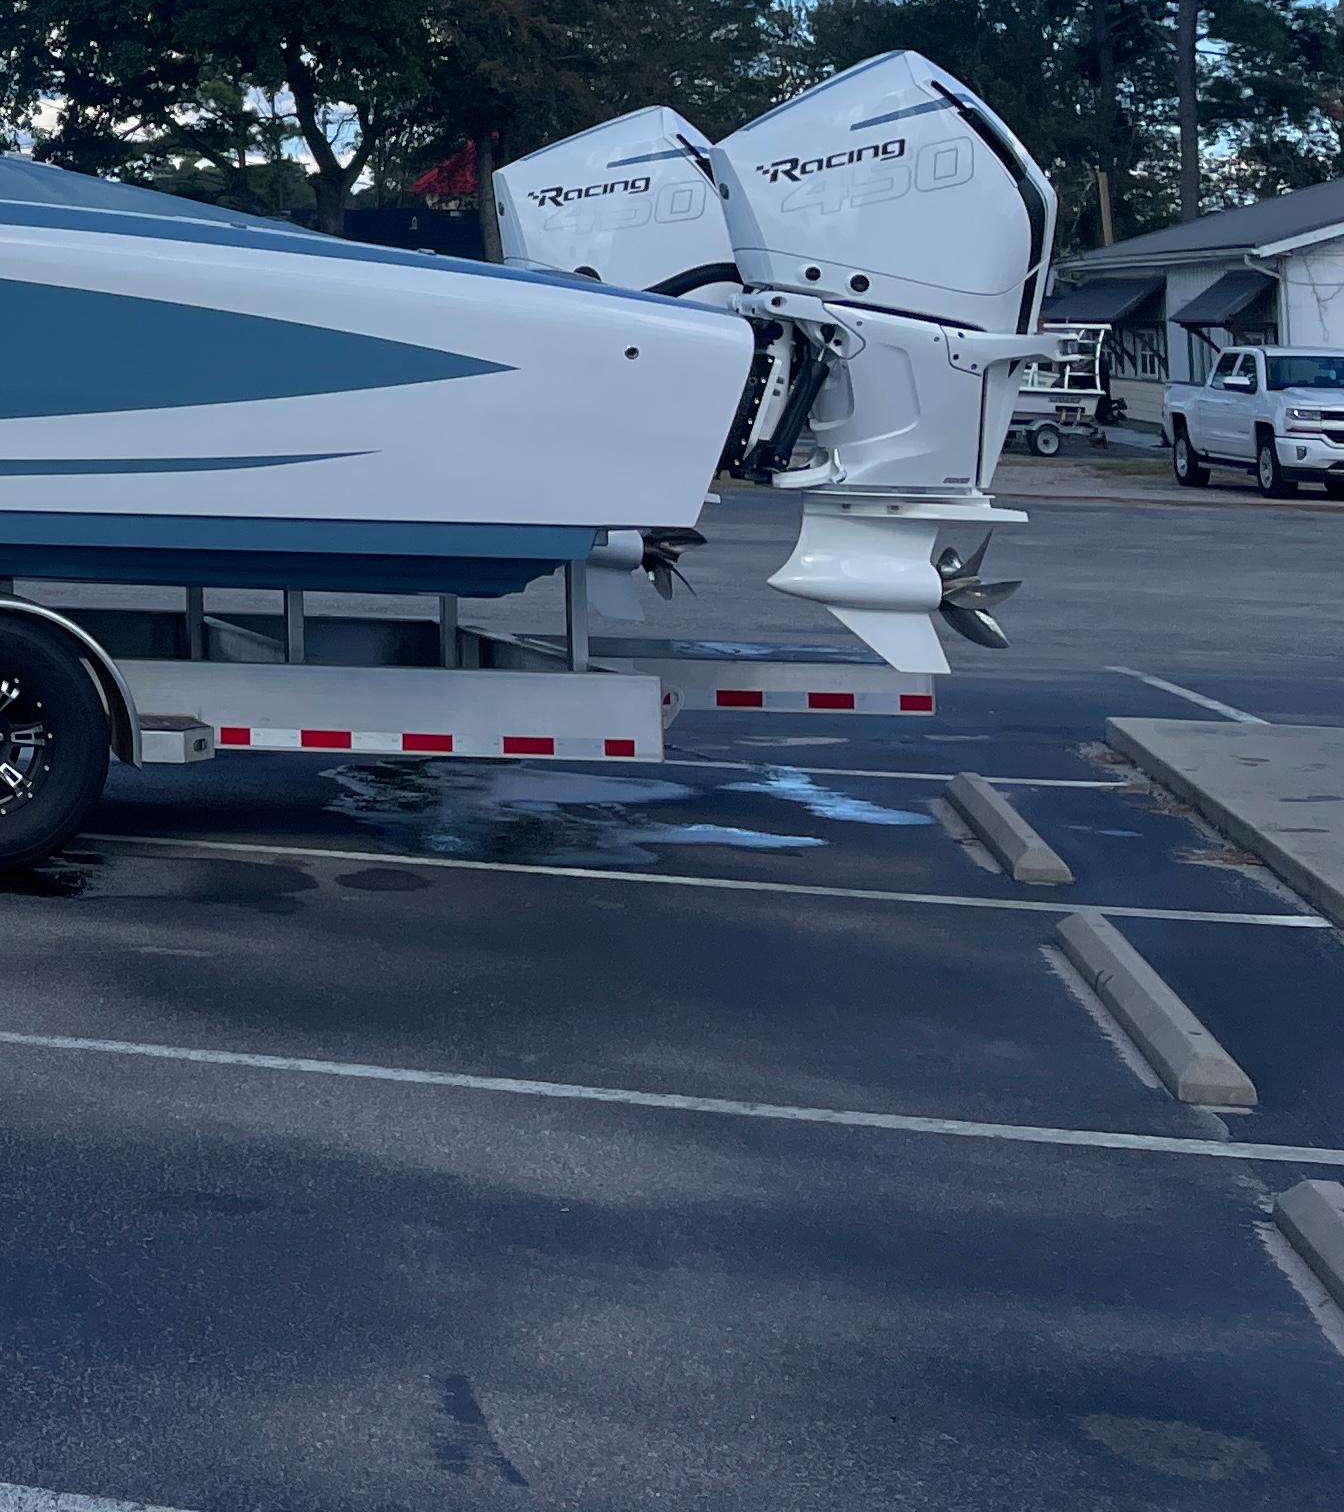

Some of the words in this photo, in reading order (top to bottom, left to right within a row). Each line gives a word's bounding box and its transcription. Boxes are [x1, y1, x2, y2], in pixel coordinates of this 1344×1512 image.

[769, 138, 905, 184] Racing
[781, 136, 975, 215] 450
[537, 176, 650, 208] Racing
